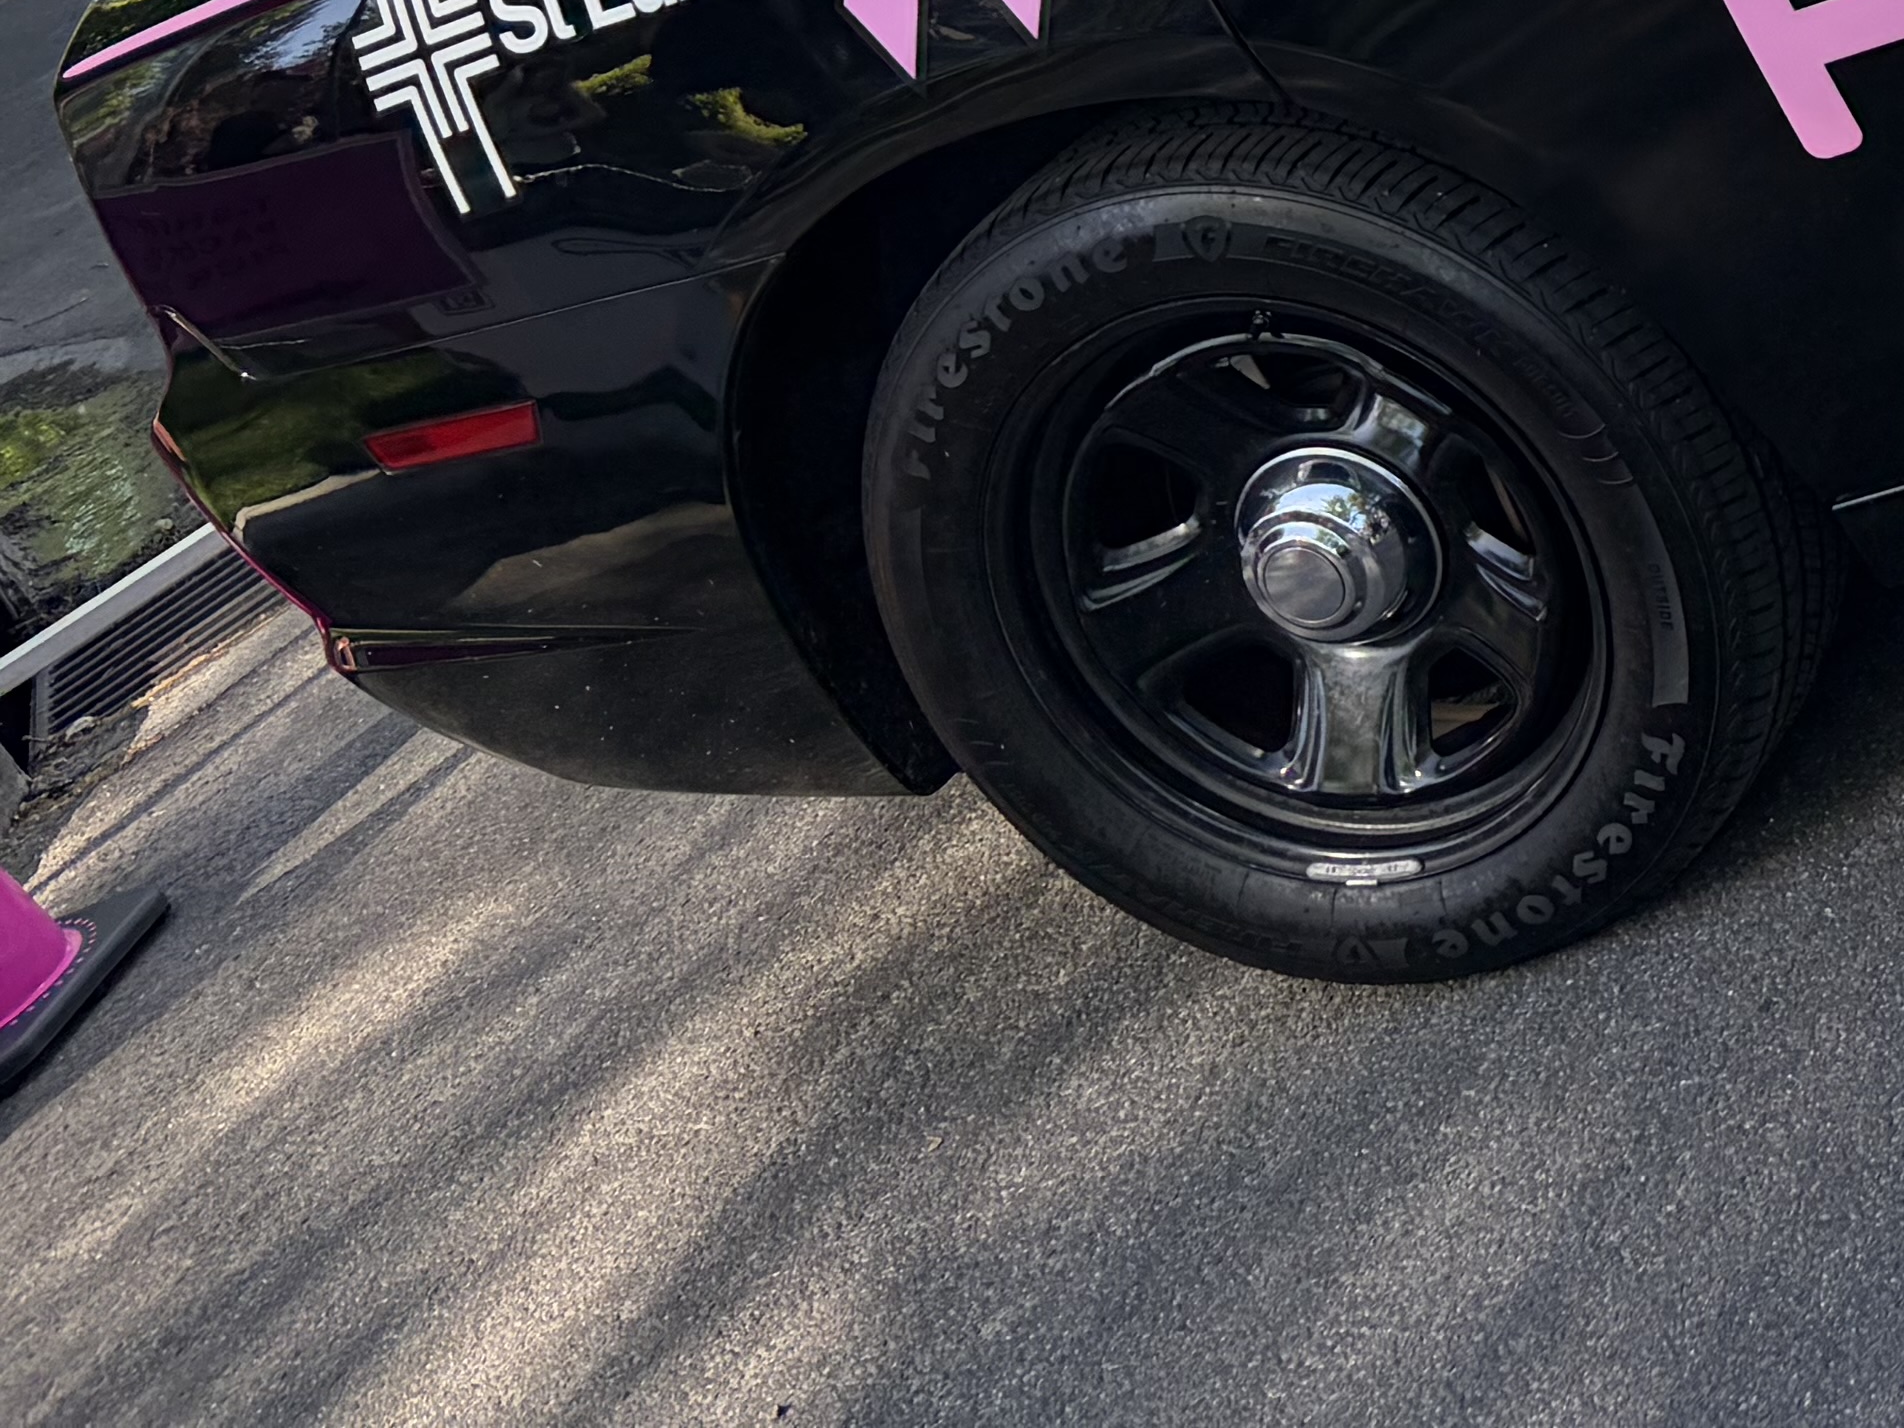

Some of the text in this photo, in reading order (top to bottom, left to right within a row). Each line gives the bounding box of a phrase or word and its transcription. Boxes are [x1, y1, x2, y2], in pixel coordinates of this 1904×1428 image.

[902, 232, 1128, 483] Firestone
[1647, 560, 1676, 634] OUTSIDE
[1431, 731, 1687, 960] Firestone
